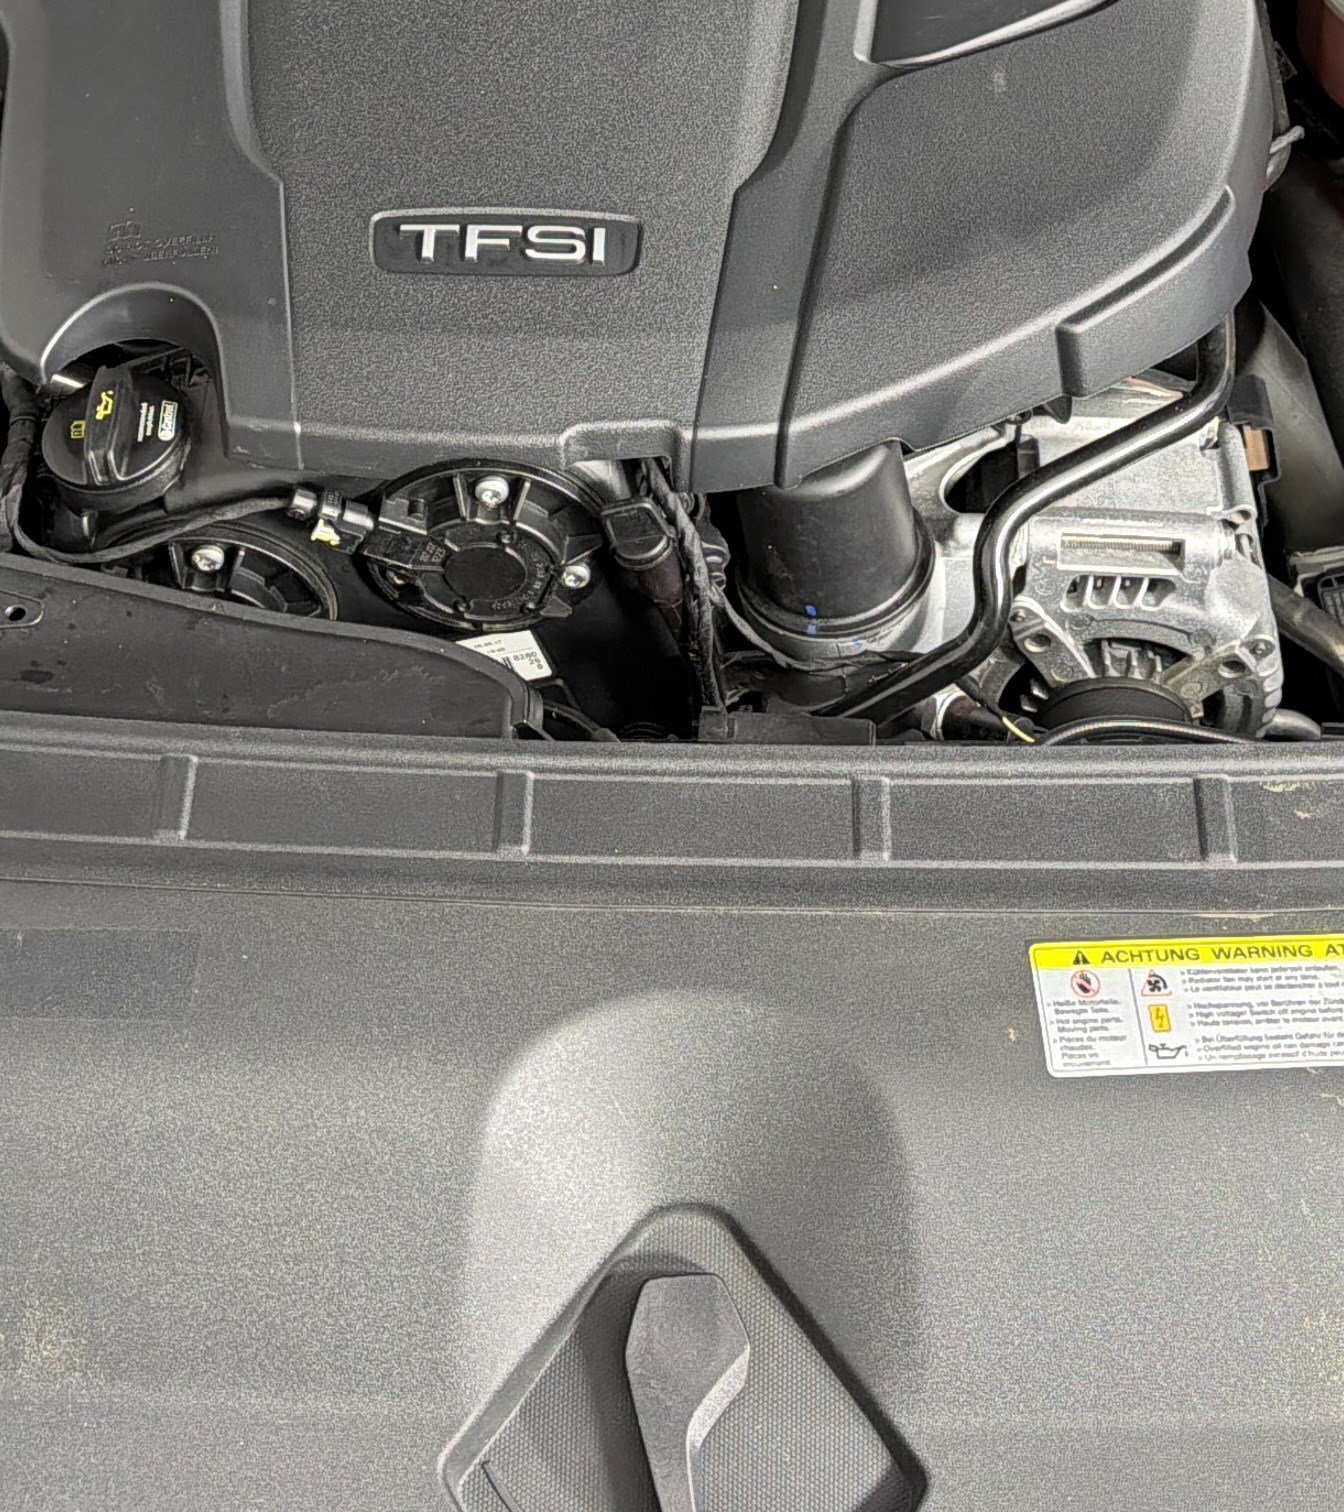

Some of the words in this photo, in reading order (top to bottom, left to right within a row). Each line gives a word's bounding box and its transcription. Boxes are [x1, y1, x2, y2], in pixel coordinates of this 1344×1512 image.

[399, 223, 606, 264] TFSI
[1101, 947, 1201, 964] ACHTUNG
[1210, 944, 1313, 961] WARNING
